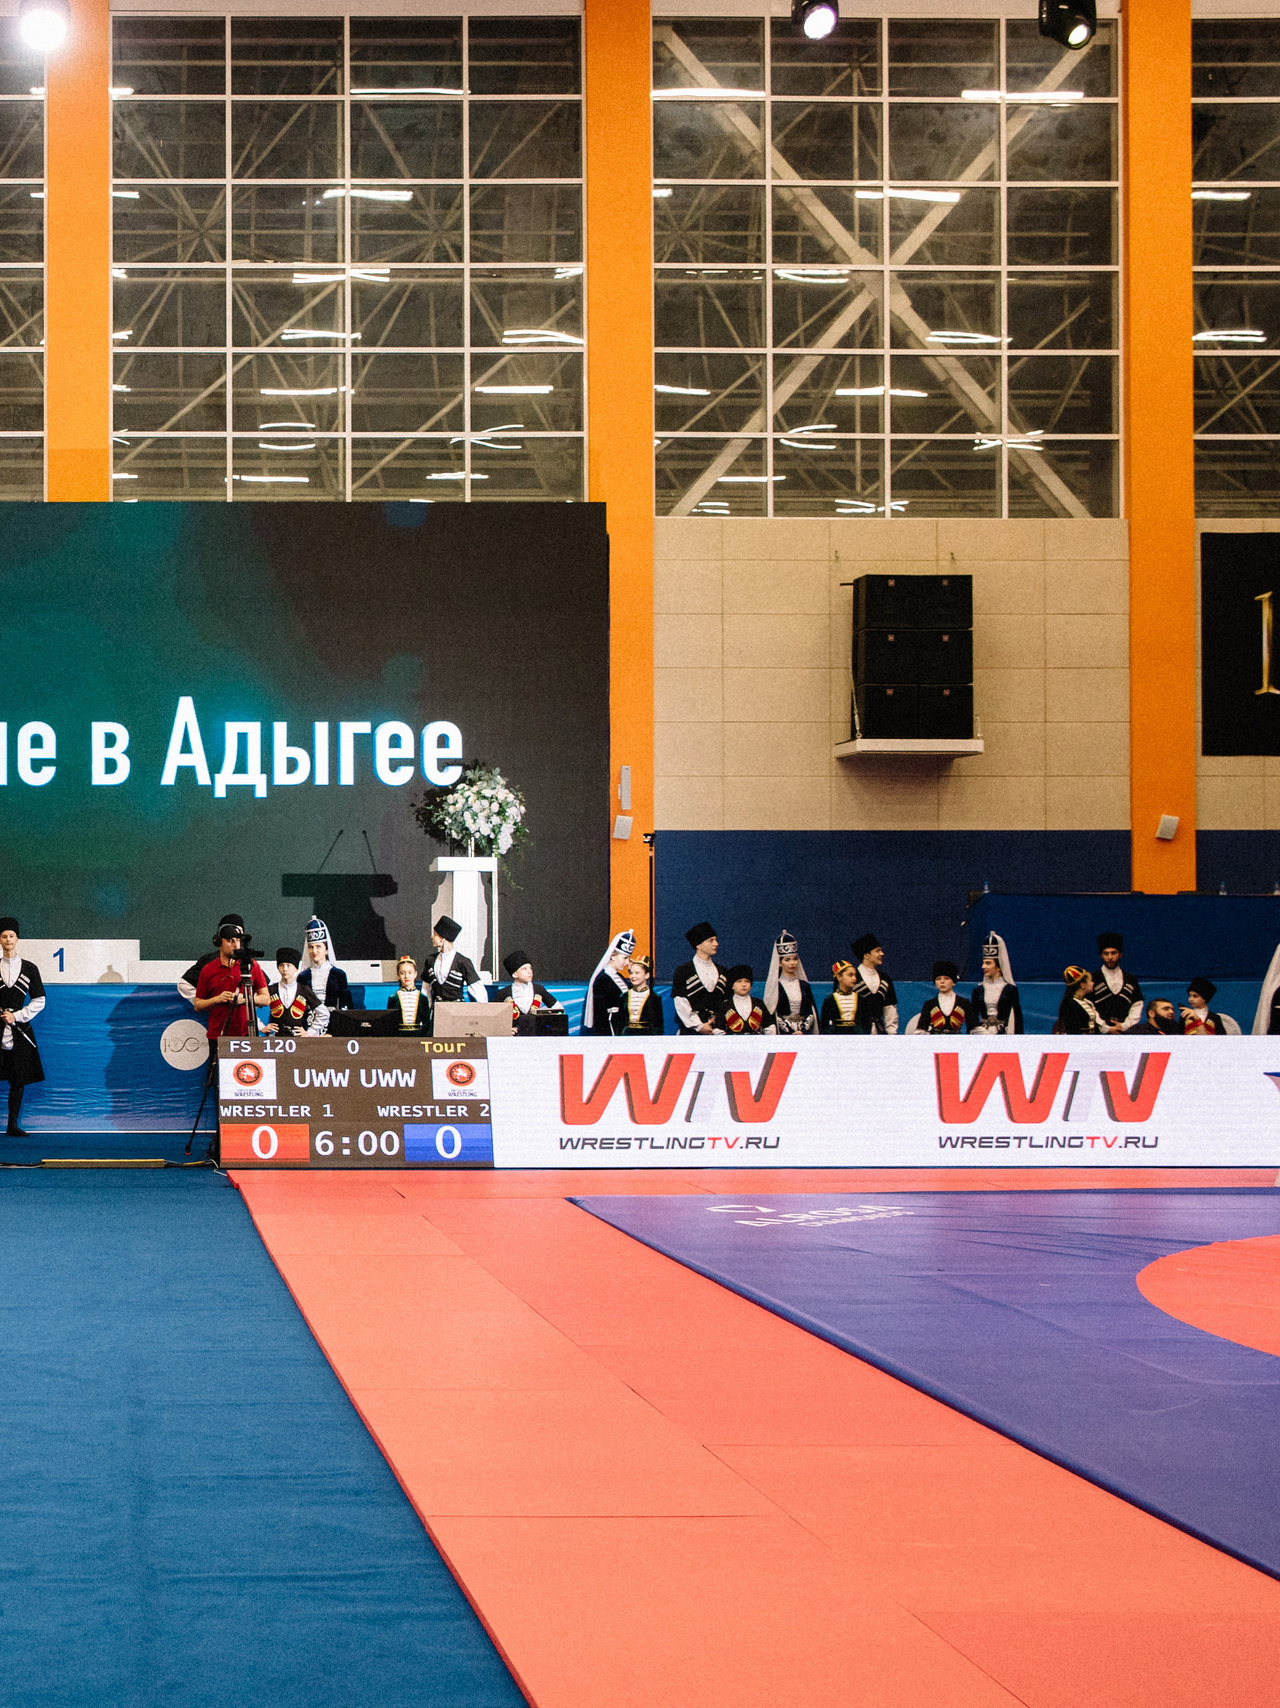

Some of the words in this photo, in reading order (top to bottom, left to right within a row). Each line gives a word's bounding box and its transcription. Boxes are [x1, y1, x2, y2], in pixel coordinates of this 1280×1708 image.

[91, 721, 131, 786] в
[160, 696, 463, 798] Адыгее
[52, 948, 65, 972] 1
[229, 1040, 252, 1053] FS
[263, 1040, 297, 1053] 120
[347, 1040, 360, 1055] 0
[420, 1041, 466, 1053] Tour
[293, 1068, 350, 1088] UWW
[360, 1068, 416, 1088] UWW
[220, 1105, 311, 1117] WRESTLER
[322, 1104, 334, 1117] 1
[377, 1105, 469, 1117] WRESTLER
[479, 1103, 490, 1117] 2
[251, 1125, 279, 1159] 0
[314, 1130, 400, 1156] 6:00
[435, 1125, 462, 1159] 0
[559, 1137, 780, 1150] WRESTLINGTV.RU
[938, 1136, 1159, 1149] WRESTLINGTV.RU
